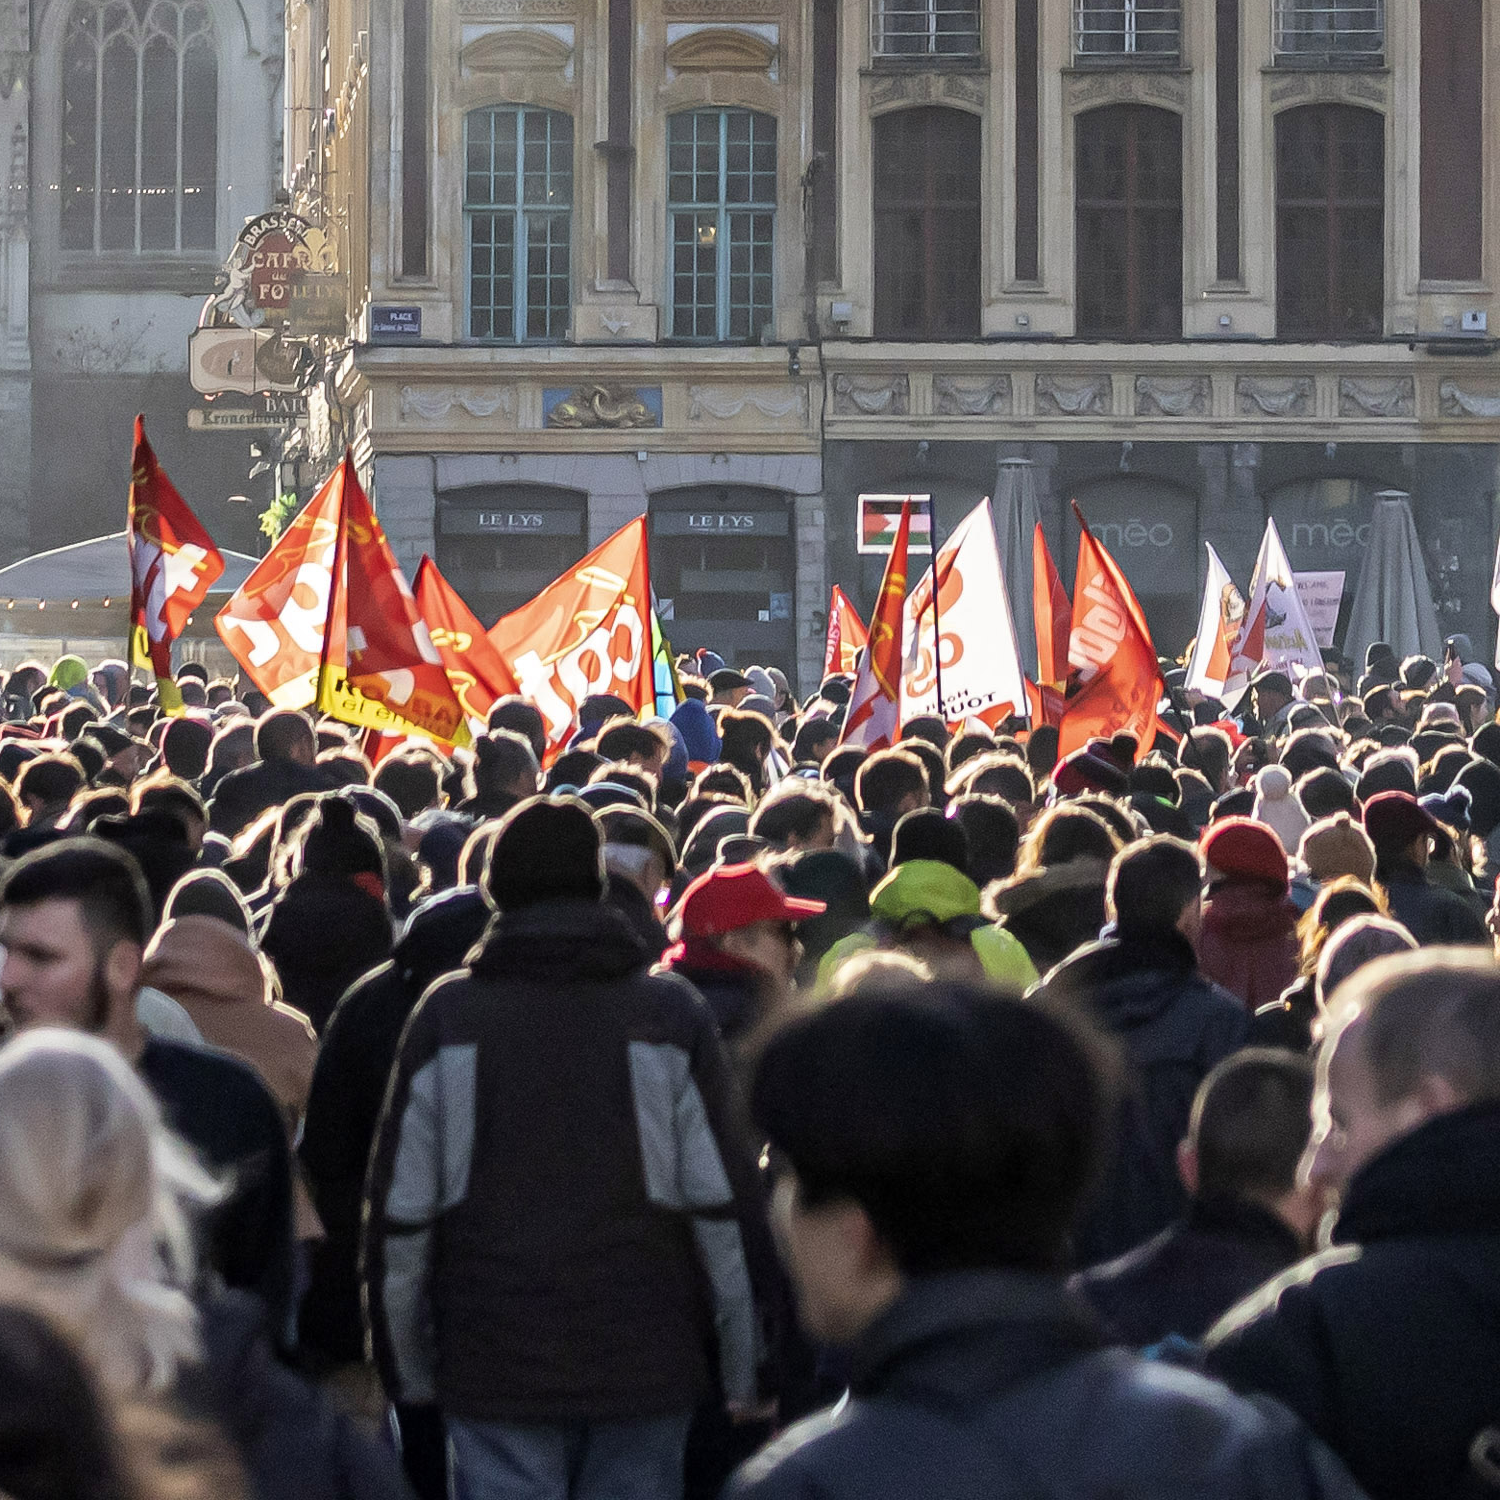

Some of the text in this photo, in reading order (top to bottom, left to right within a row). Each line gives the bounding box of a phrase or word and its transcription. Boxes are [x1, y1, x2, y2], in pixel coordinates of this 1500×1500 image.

[259, 284, 290, 300] FO
[479, 513, 543, 526] LE LYS
[688, 514, 754, 527] LE LYS
